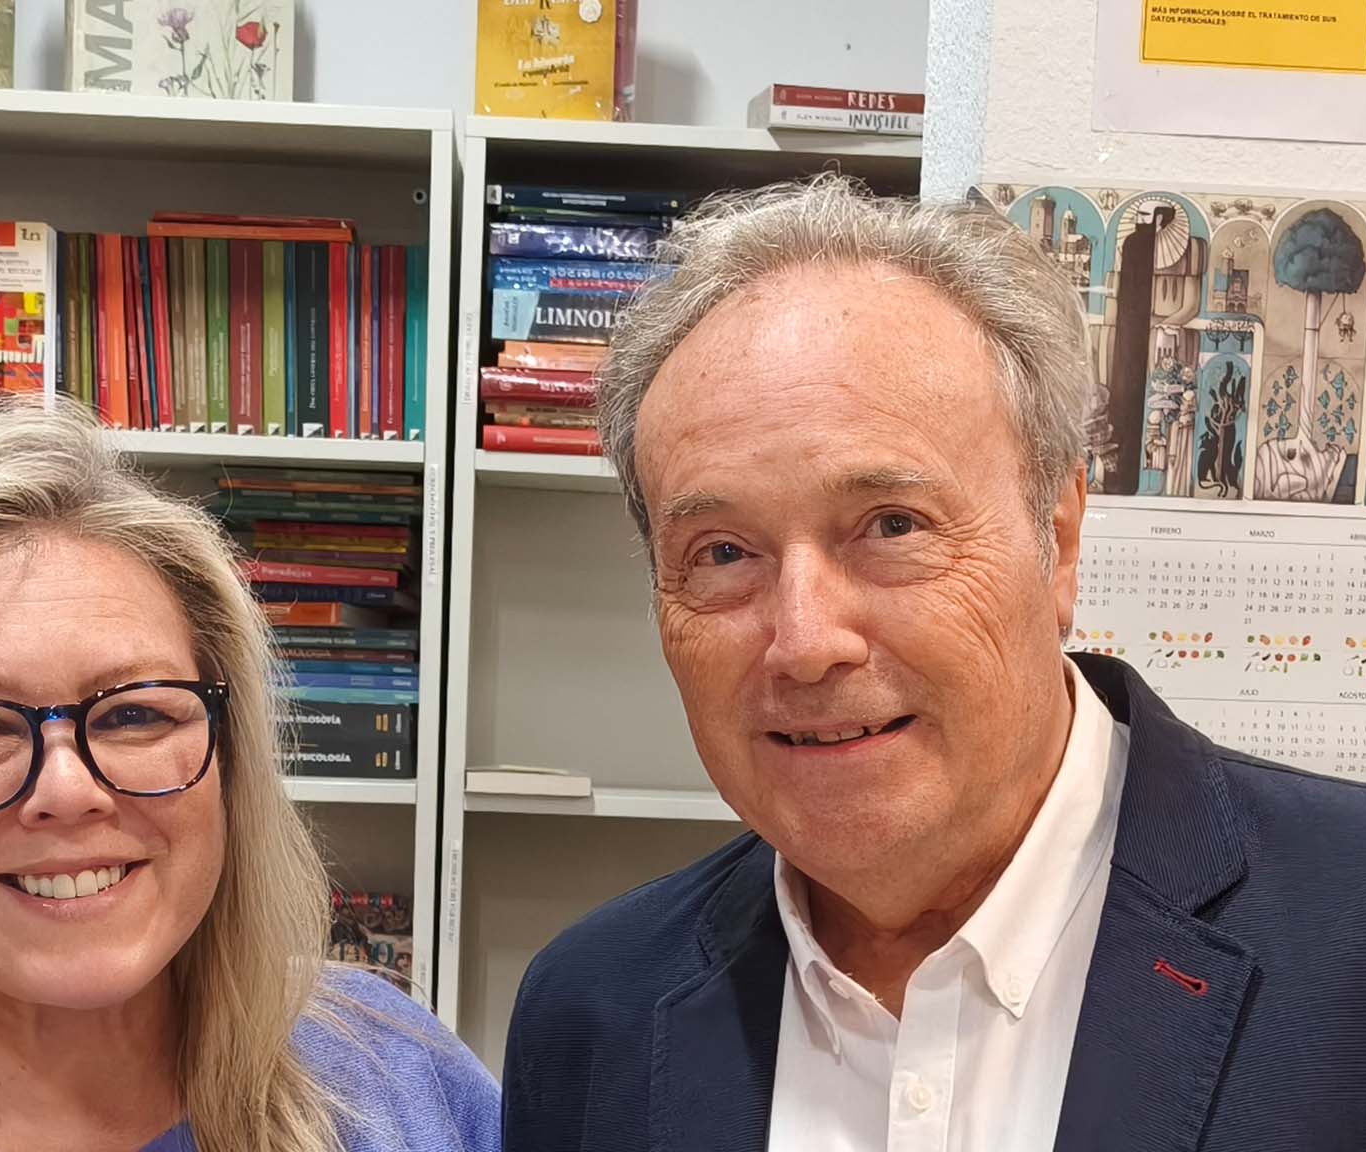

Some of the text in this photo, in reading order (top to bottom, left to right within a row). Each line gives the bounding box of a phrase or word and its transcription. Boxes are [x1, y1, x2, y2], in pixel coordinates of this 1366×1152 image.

[1221, 9, 1246, 18] SOBRE
[1258, 12, 1309, 21] TRATAMIENTO
[1178, 17, 1226, 26] PERSONALES
[1249, 530, 1275, 538] MARZO
